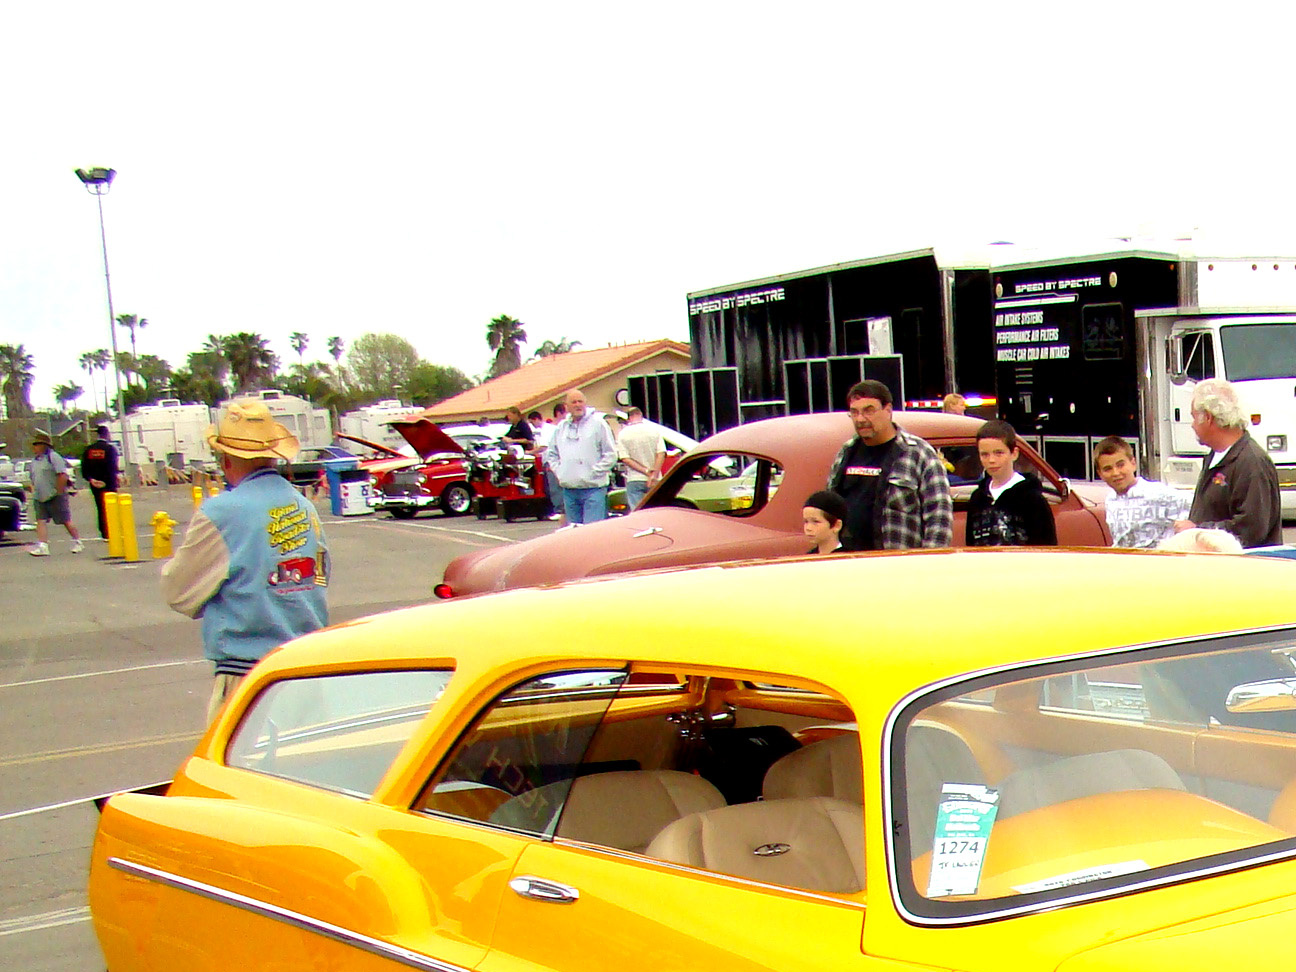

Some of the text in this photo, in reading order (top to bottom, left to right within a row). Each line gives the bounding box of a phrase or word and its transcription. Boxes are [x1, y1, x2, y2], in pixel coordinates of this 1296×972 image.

[1015, 277, 1101, 293] SPEED BY SPECTRE
[689, 287, 786, 315] SPEED BY SPECTRE
[995, 311, 1043, 327] AIR INTAKE SYSTEMS
[996, 327, 1060, 344] PERFORMANCE AIR FILTERS
[997, 345, 1071, 361] MUSCLE CAR COLD AIR INTAKES
[269, 499, 300, 519] Grand
[267, 509, 308, 535] National
[279, 536, 308, 555] Show
[939, 841, 979, 855] 1274
